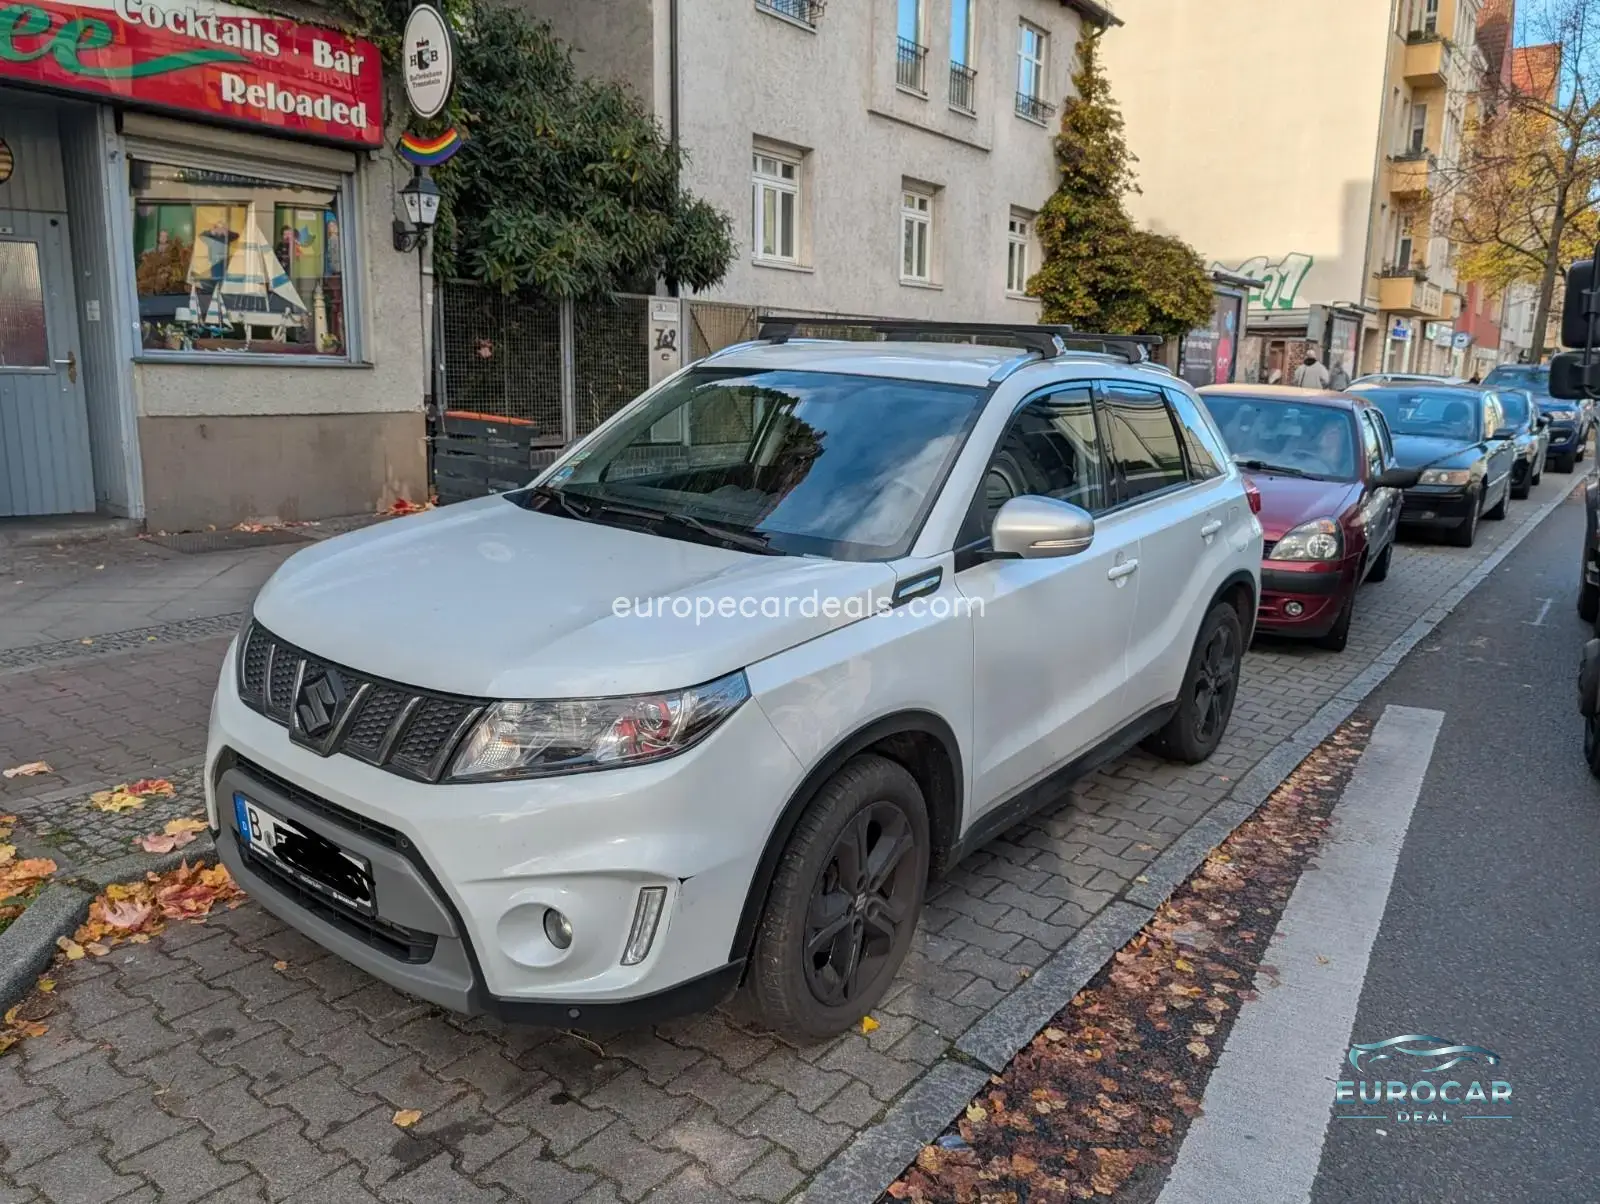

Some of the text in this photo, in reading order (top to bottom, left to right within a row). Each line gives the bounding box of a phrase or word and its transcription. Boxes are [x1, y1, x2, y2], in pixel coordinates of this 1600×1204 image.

[114, 0, 280, 56] Cocktails
[312, 39, 364, 75] Bar
[221, 72, 366, 128] Reloaded
